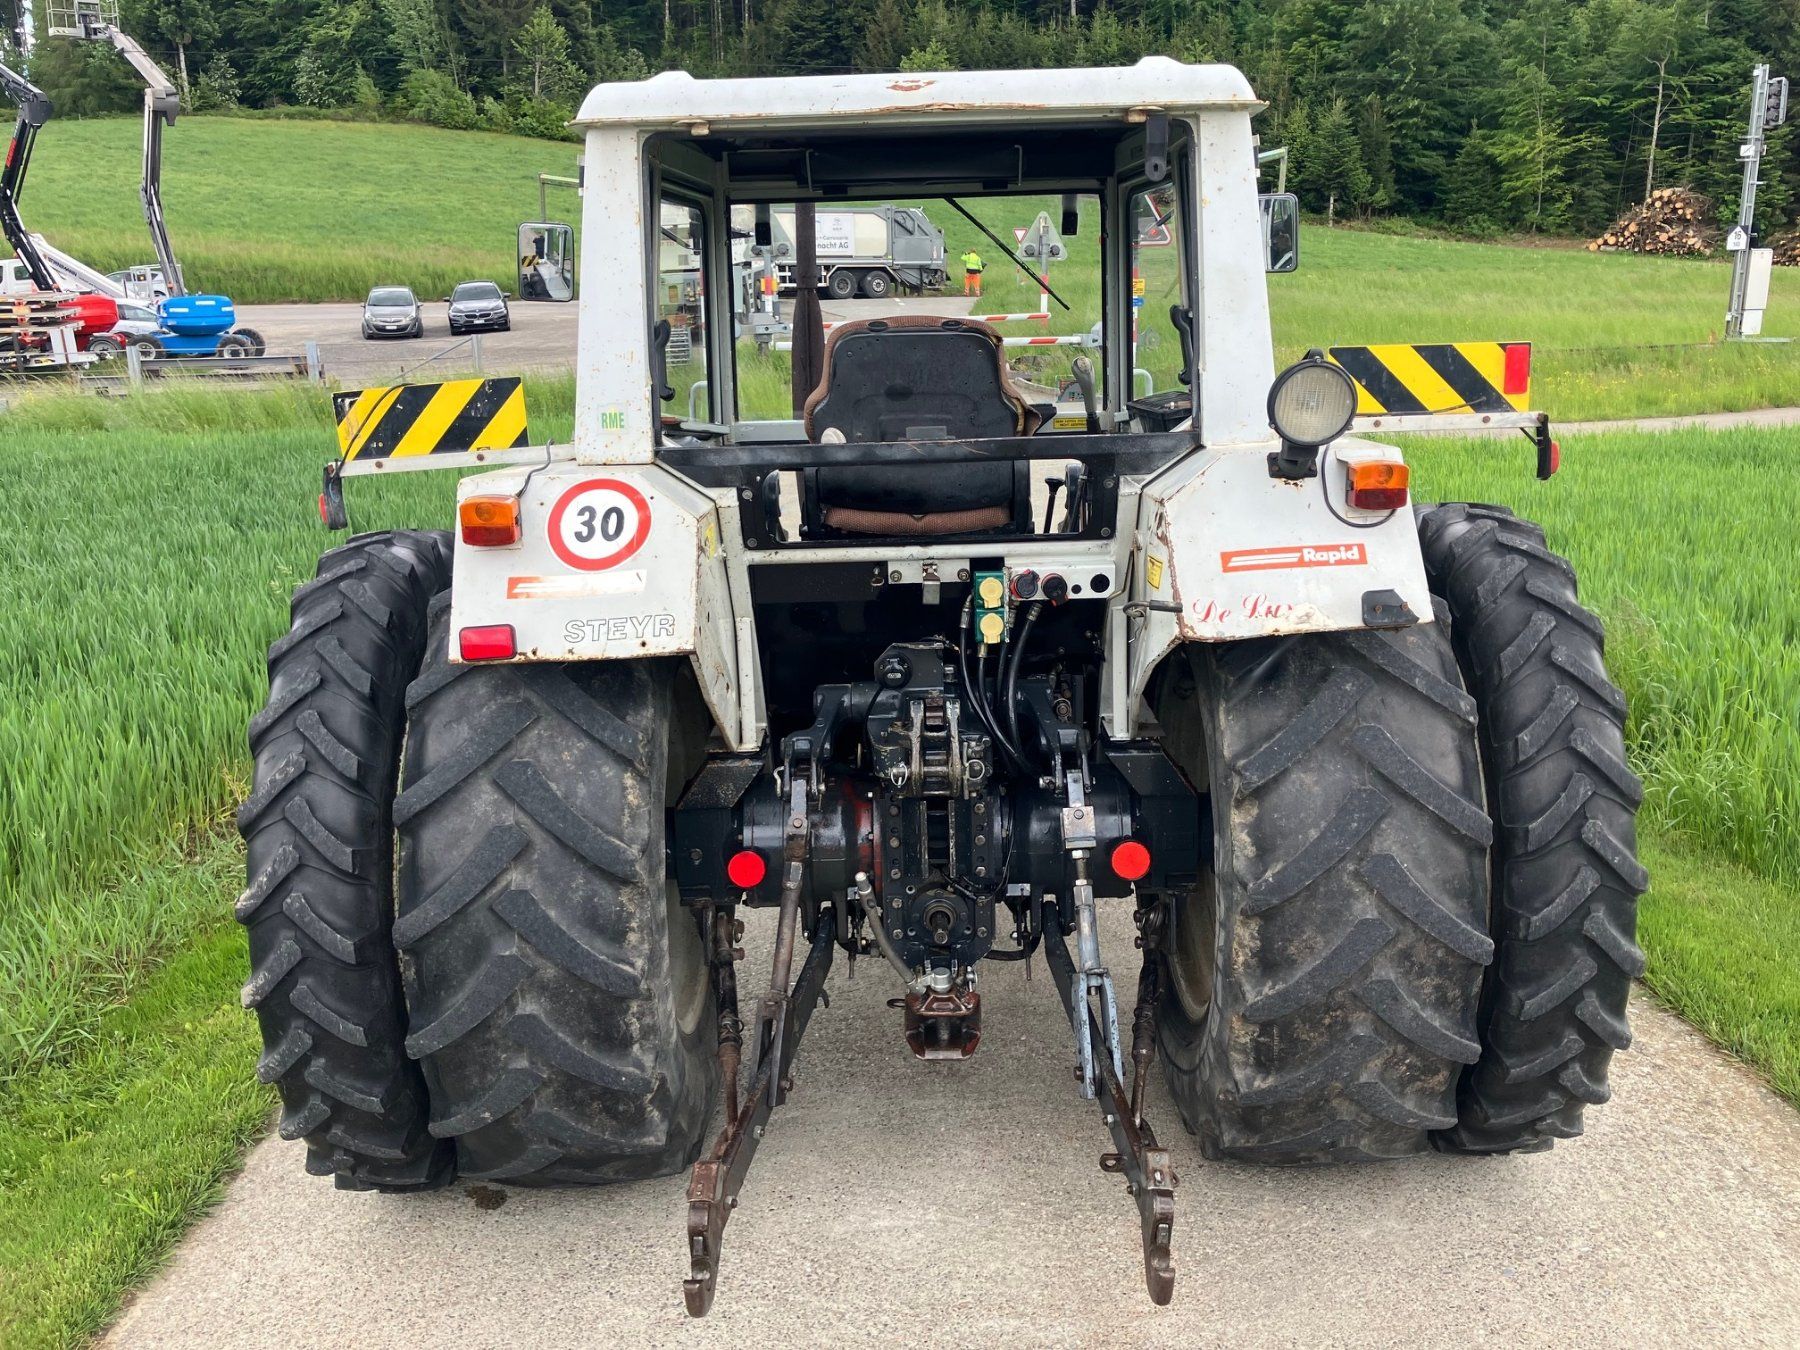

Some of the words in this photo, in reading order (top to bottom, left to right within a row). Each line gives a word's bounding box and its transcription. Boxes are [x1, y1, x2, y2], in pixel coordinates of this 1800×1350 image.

[838, 241, 849, 249] AG
[601, 412, 625, 429] RME
[574, 505, 625, 543] 30
[1302, 545, 1360, 564] Rapid
[1193, 598, 1231, 623] De
[563, 613, 676, 644] STEYR
